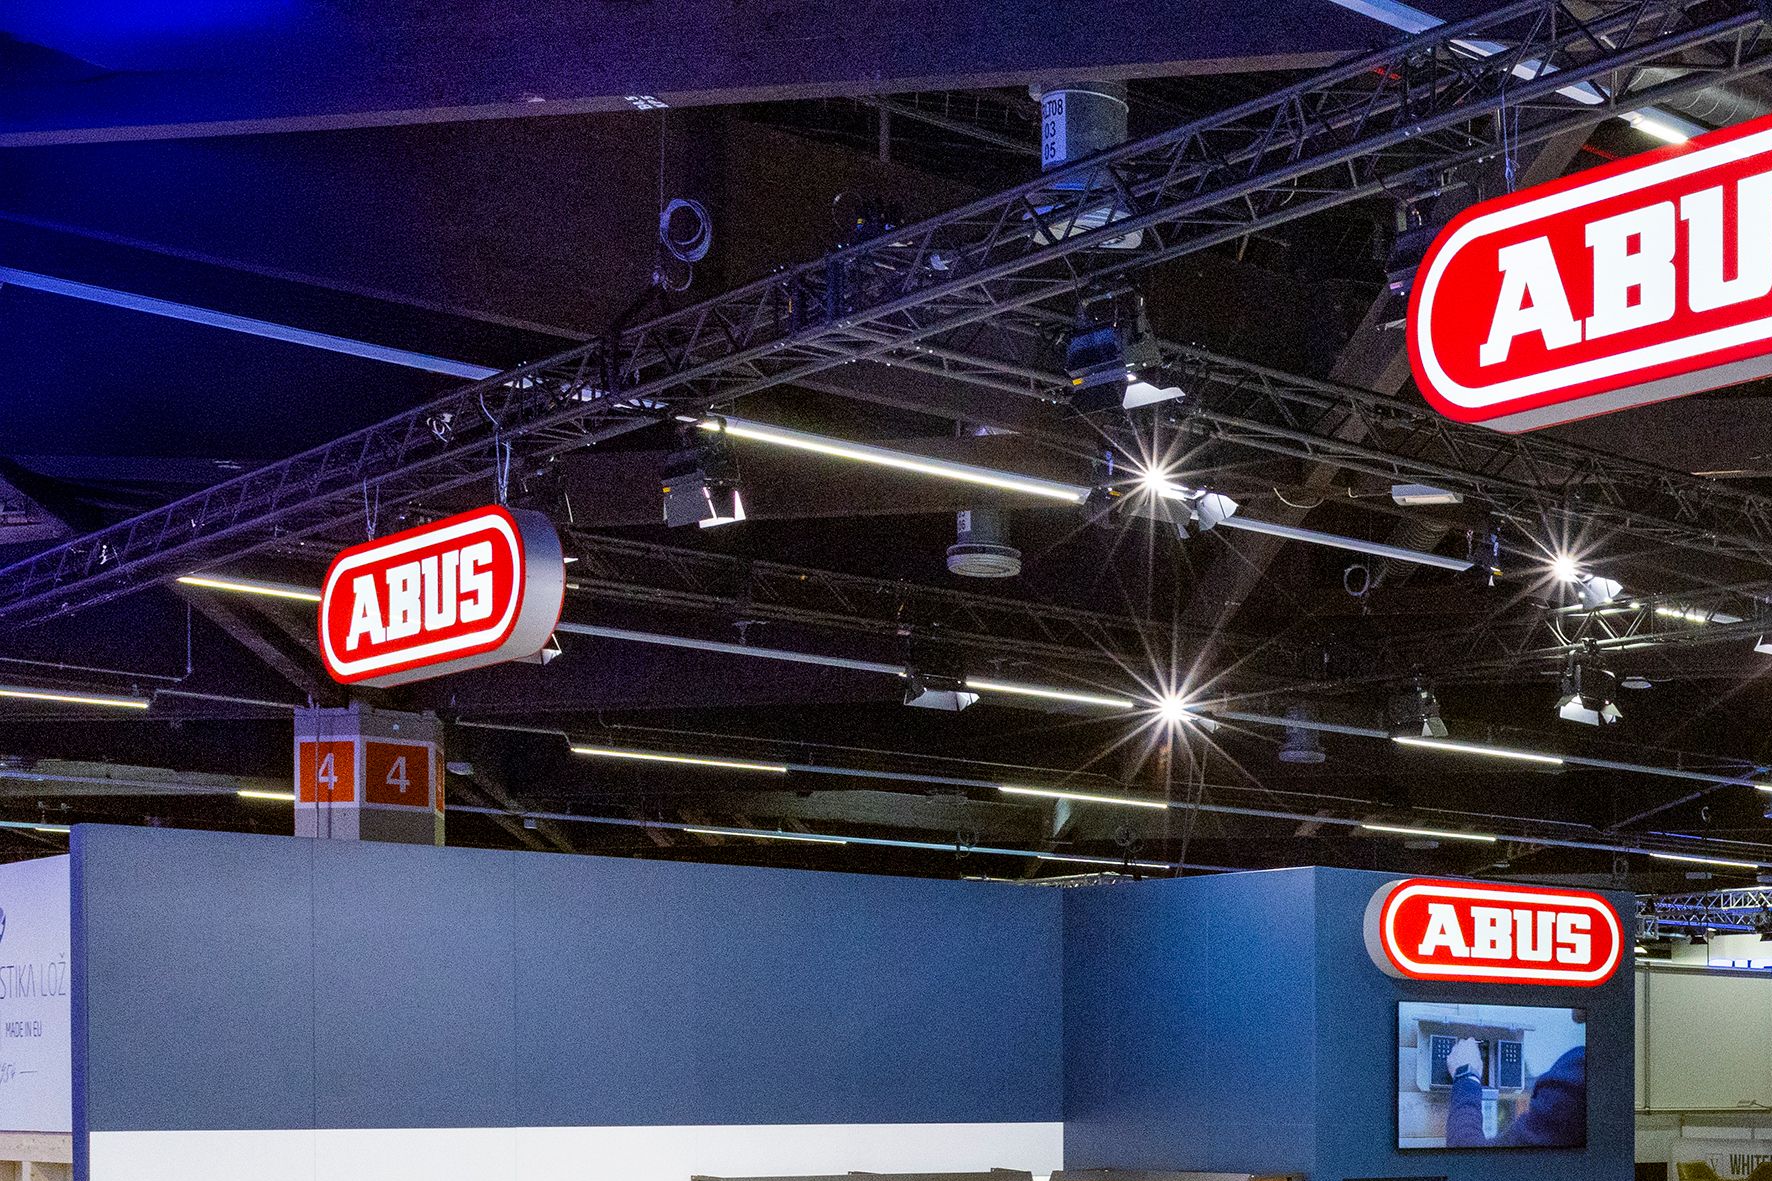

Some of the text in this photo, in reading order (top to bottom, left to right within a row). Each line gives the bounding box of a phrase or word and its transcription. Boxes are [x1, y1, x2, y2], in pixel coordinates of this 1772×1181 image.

[1045, 121, 1056, 139] 03
[1045, 142, 1056, 160] 05
[346, 541, 492, 650] ABUS
[318, 752, 339, 790] 4
[386, 756, 411, 793] 4
[1419, 903, 1591, 964] ABUS
[6, 1020, 42, 1038] MADE IN EU
